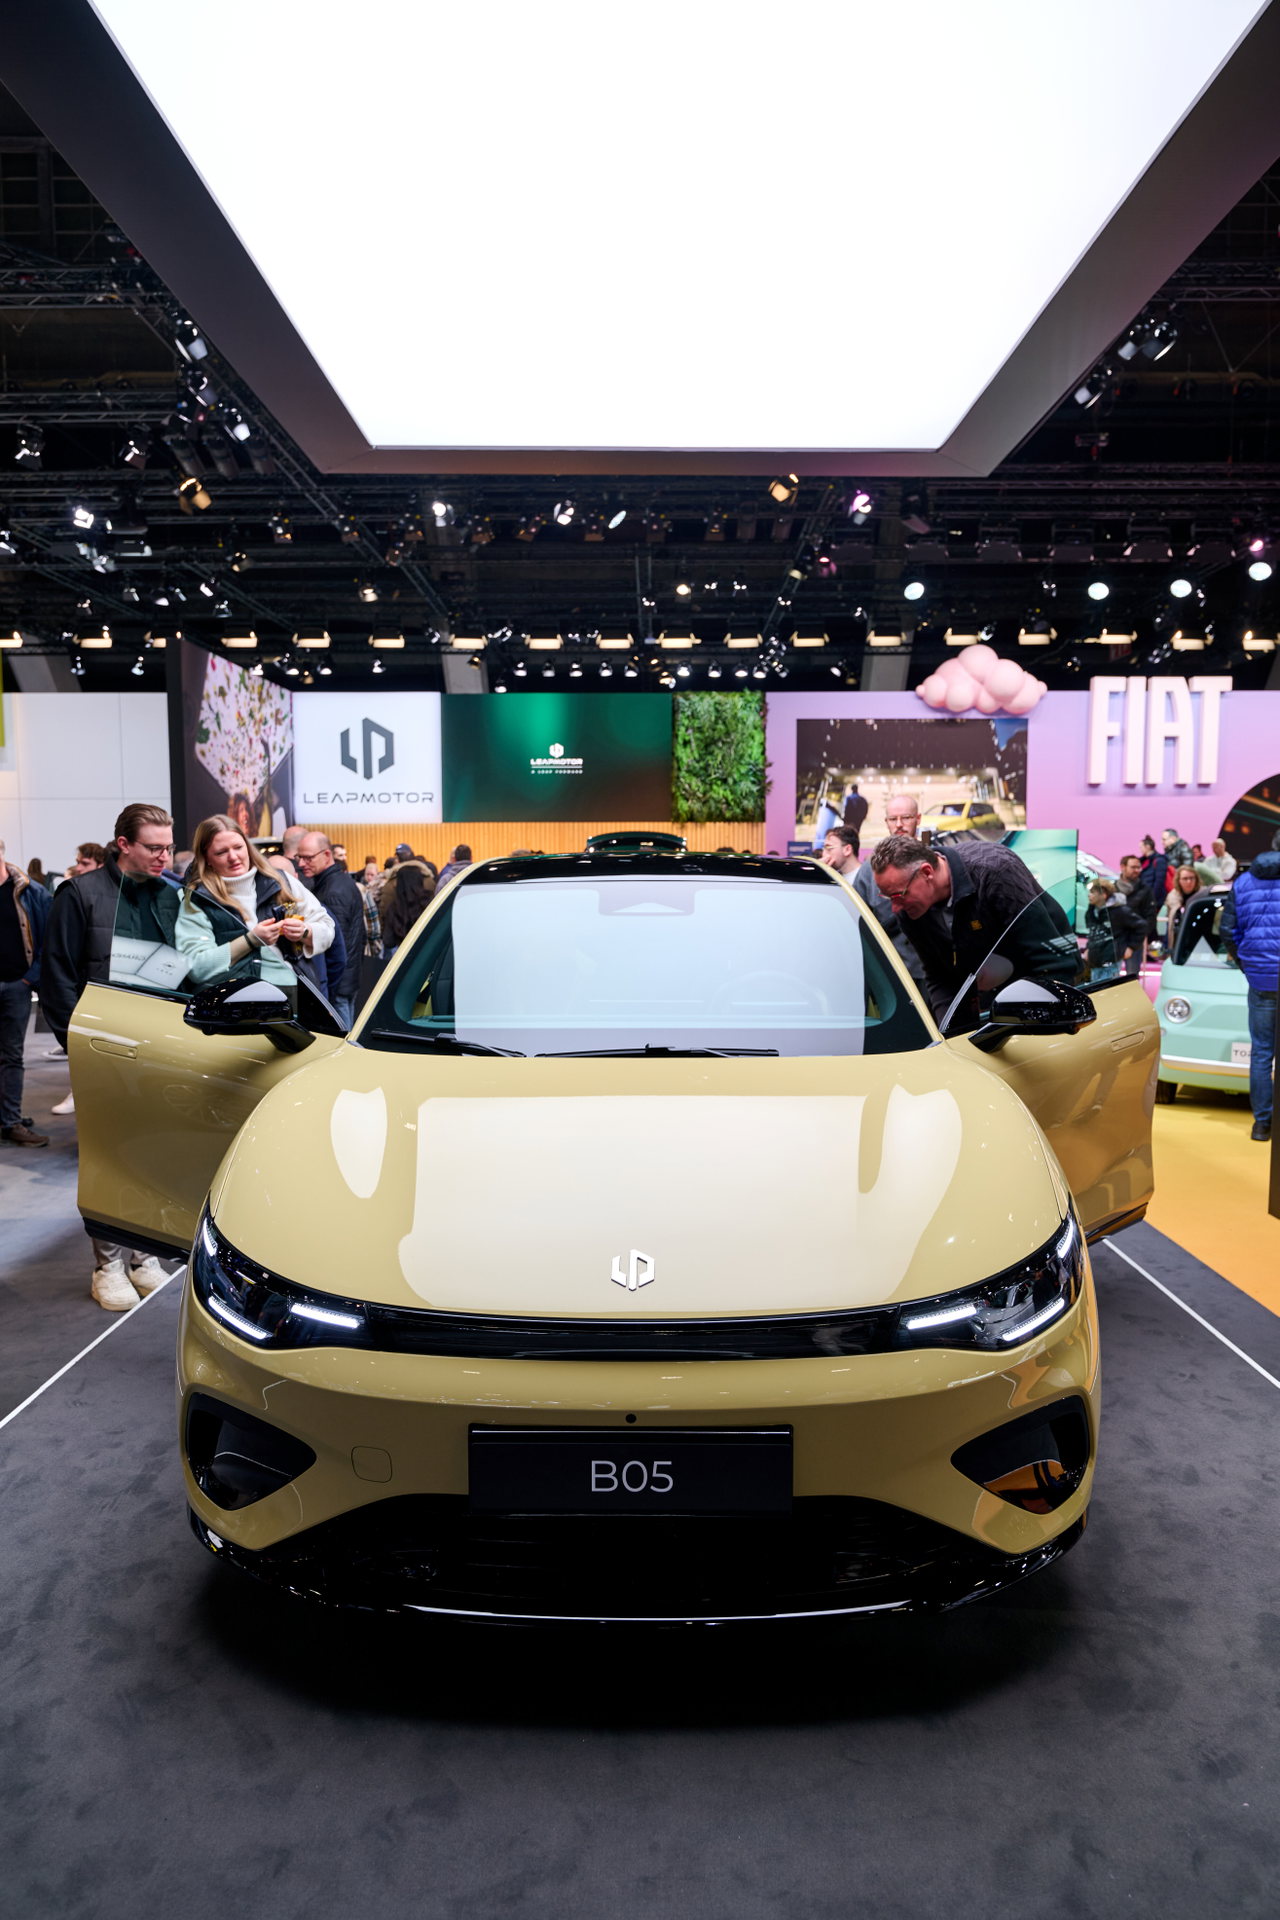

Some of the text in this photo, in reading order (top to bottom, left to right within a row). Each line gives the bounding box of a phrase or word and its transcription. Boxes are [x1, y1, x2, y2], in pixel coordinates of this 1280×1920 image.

[1086, 675, 1233, 787] FIAT
[303, 792, 435, 804] LEAPMOTOR
[591, 1460, 674, 1493] B05
